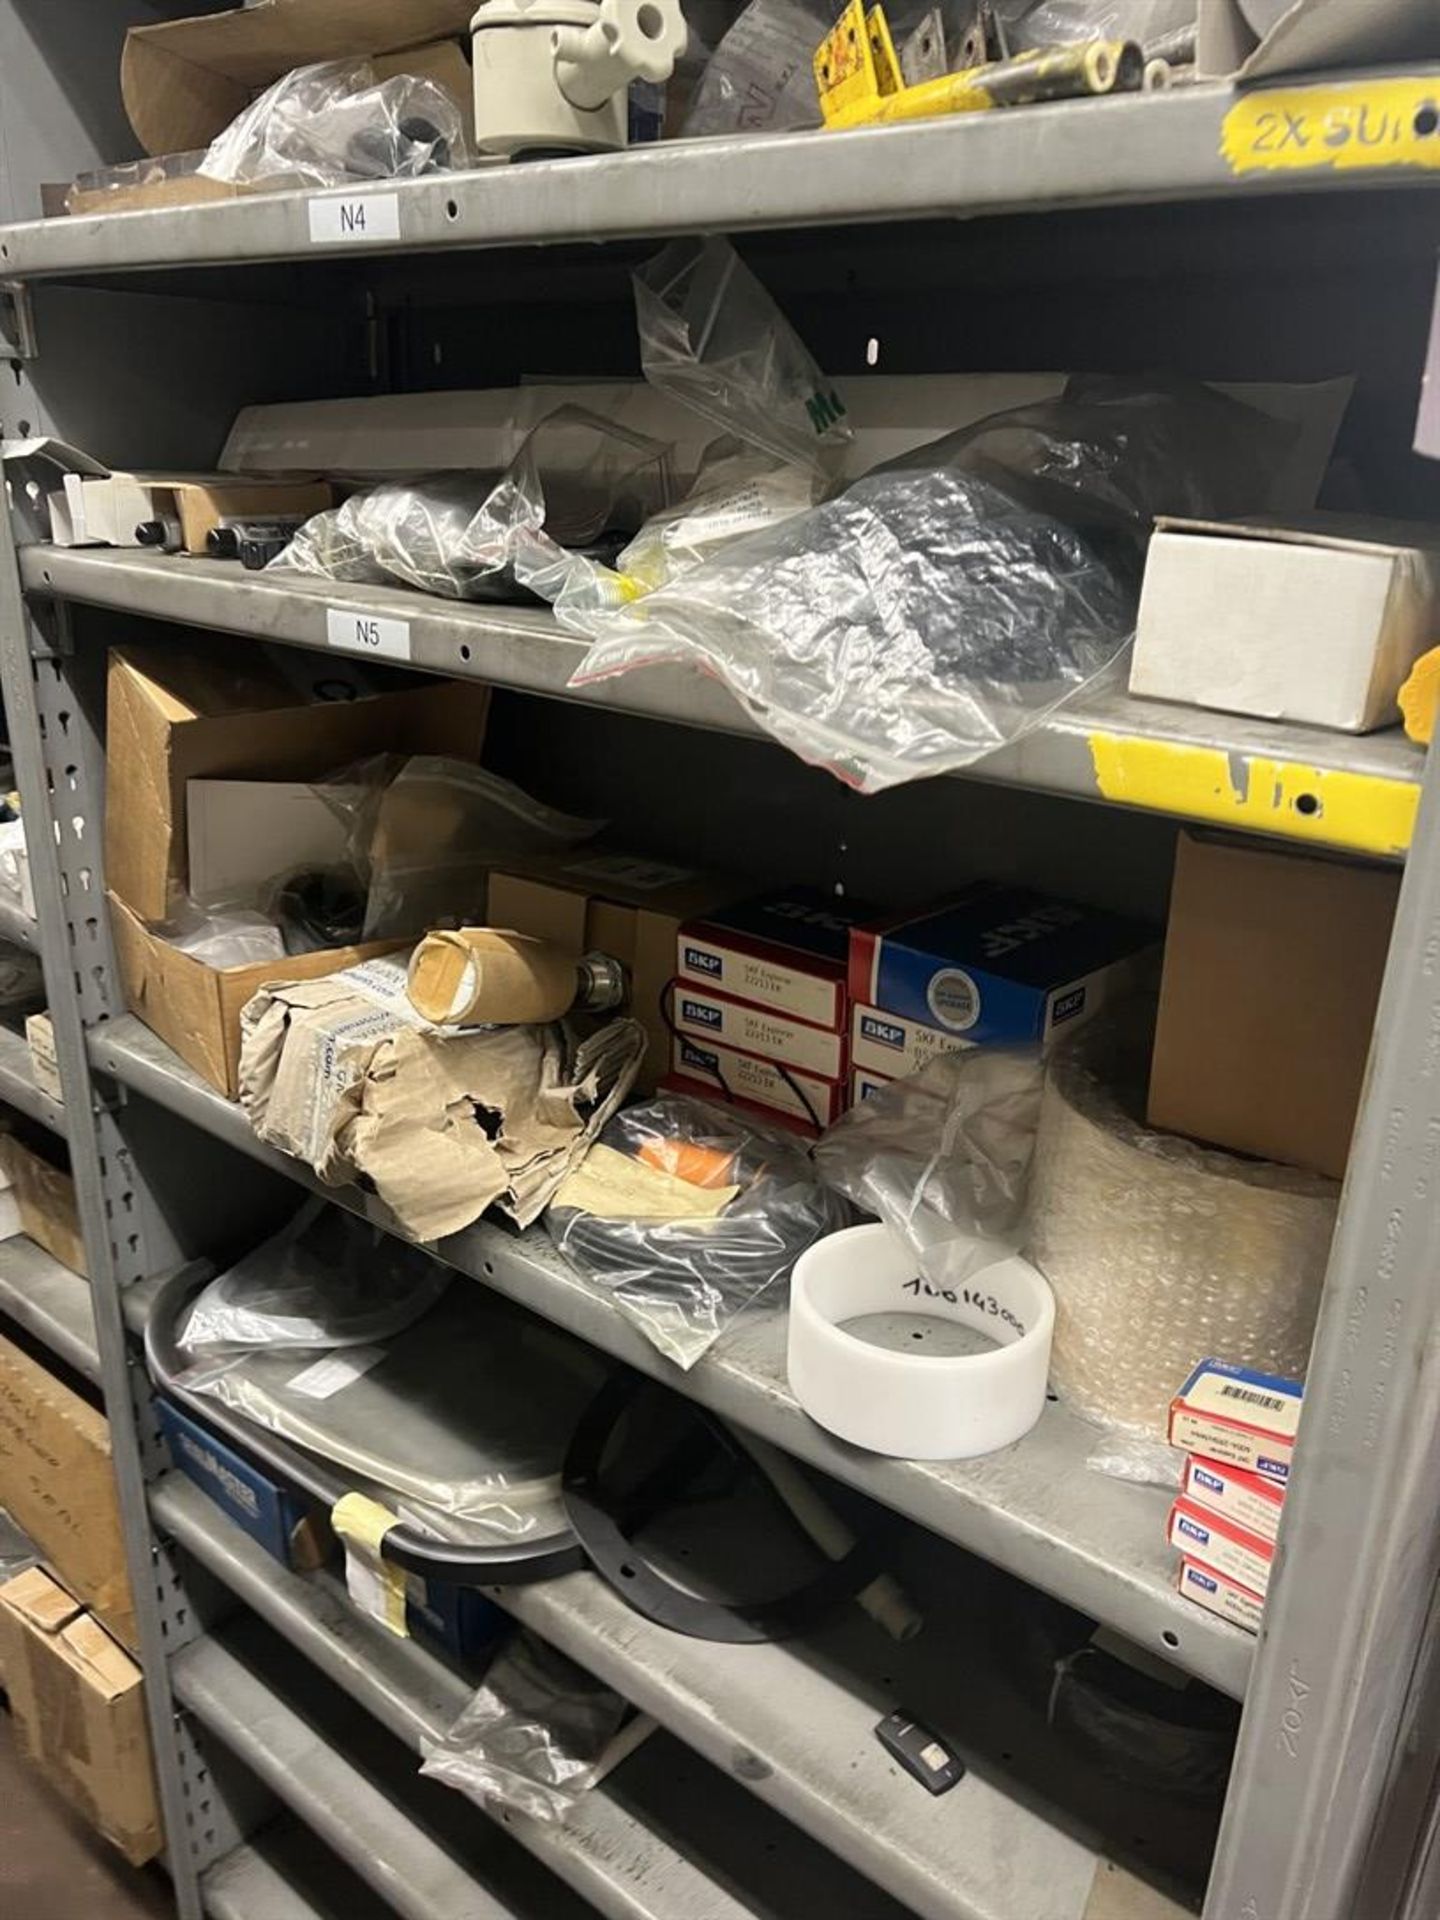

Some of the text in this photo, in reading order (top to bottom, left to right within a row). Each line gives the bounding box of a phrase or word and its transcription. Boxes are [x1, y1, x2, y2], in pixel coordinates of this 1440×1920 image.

[341, 204, 365, 232] N4
[356, 621, 380, 646] N5
[687, 951, 720, 972] SKF
[685, 1003, 720, 1023] SKF
[864, 1019, 903, 1042] SKF
[915, 1029, 935, 1046] SKF
[1259, 1460, 1287, 1475] SKF
[1196, 1471, 1222, 1490] SKF
[1181, 1521, 1208, 1542] SKF
